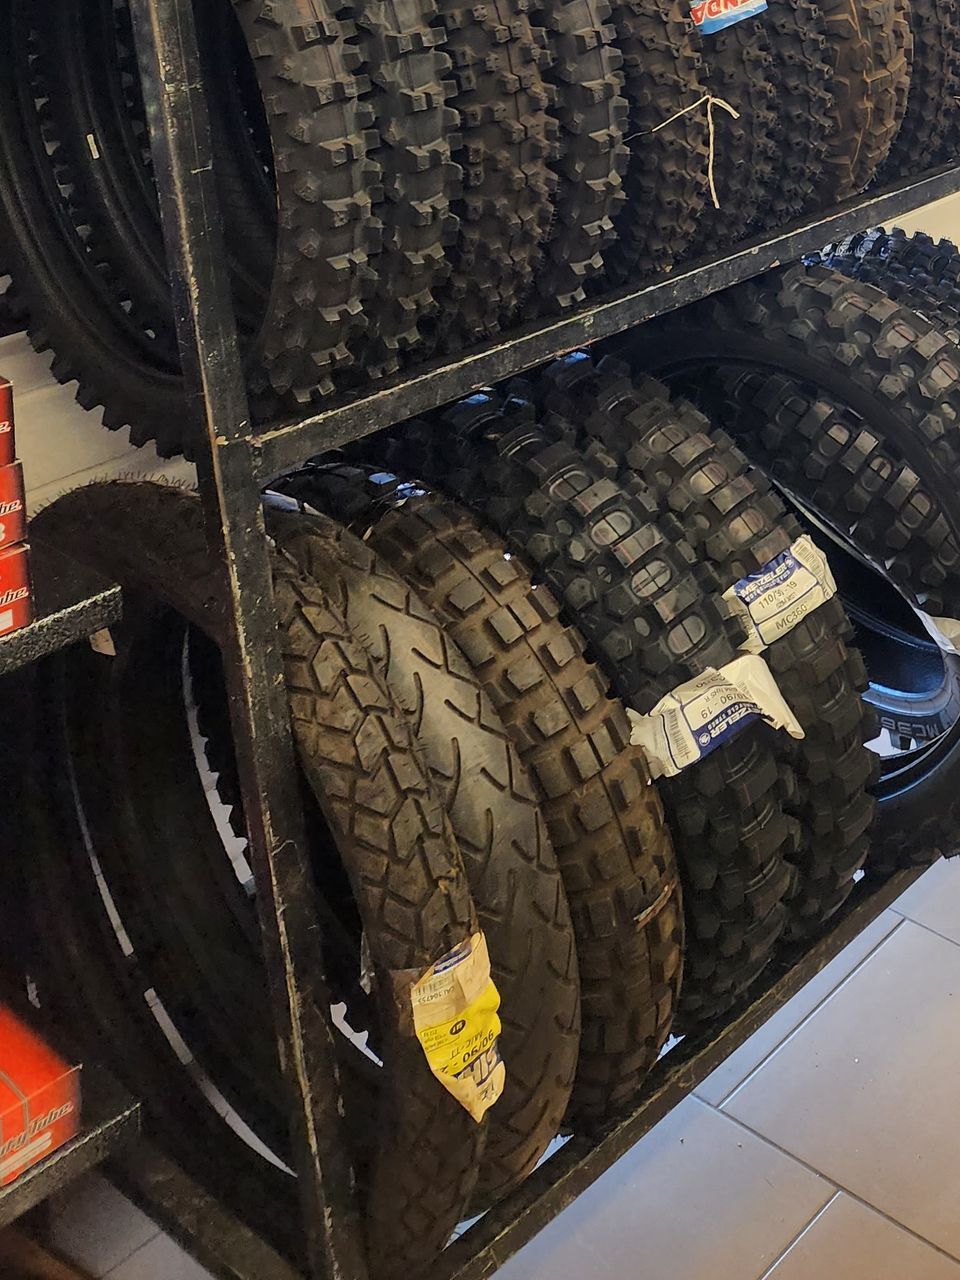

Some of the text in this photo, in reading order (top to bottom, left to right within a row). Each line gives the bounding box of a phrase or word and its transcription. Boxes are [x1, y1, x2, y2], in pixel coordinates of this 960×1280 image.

[740, 561, 788, 597] METZELER
[786, 580, 798, 591] 19
[775, 603, 808, 631] MC360
[701, 706, 713, 720] 19
[462, 1028, 495, 1064] 90/90
